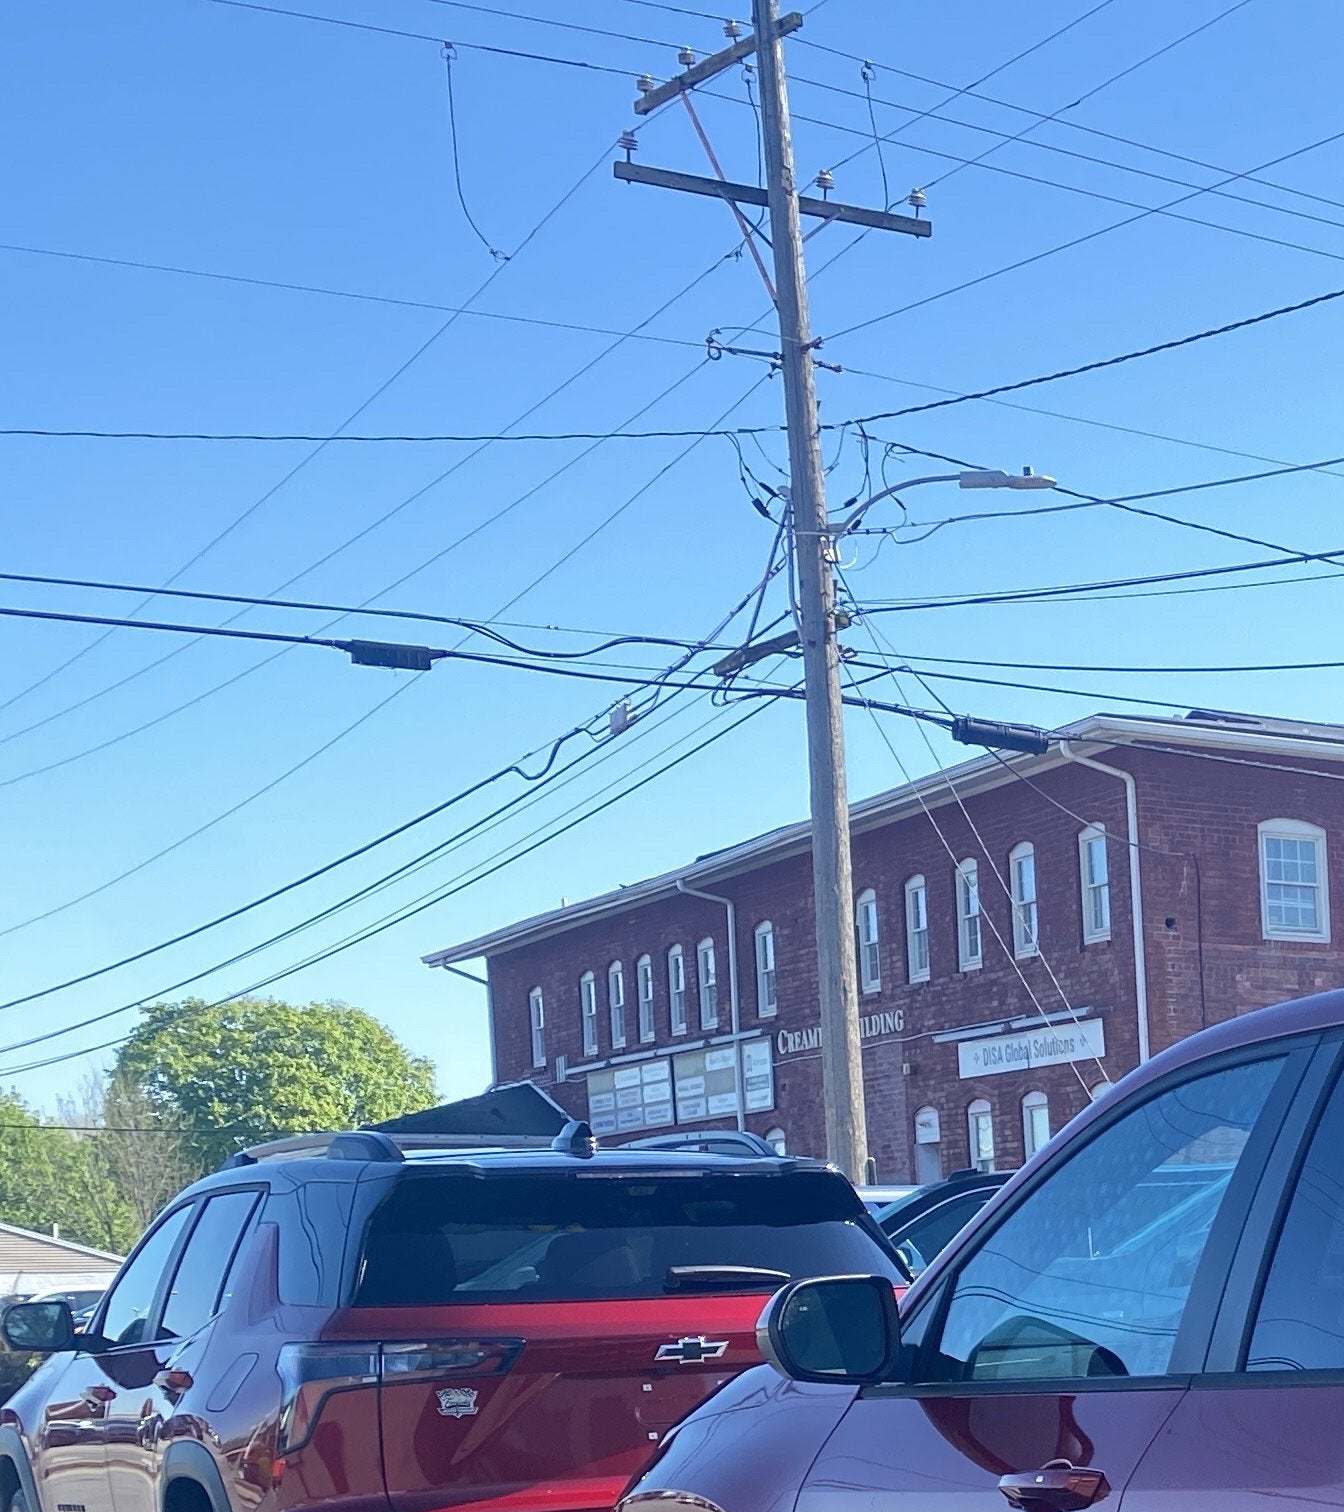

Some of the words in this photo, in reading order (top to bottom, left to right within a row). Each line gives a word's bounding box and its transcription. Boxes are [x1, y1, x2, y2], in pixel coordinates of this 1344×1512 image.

[858, 1009, 904, 1039] ILDING
[982, 1047, 1003, 1067] DISA
[1004, 1039, 1032, 1063] Global
[1033, 1036, 1075, 1059] Solutions
